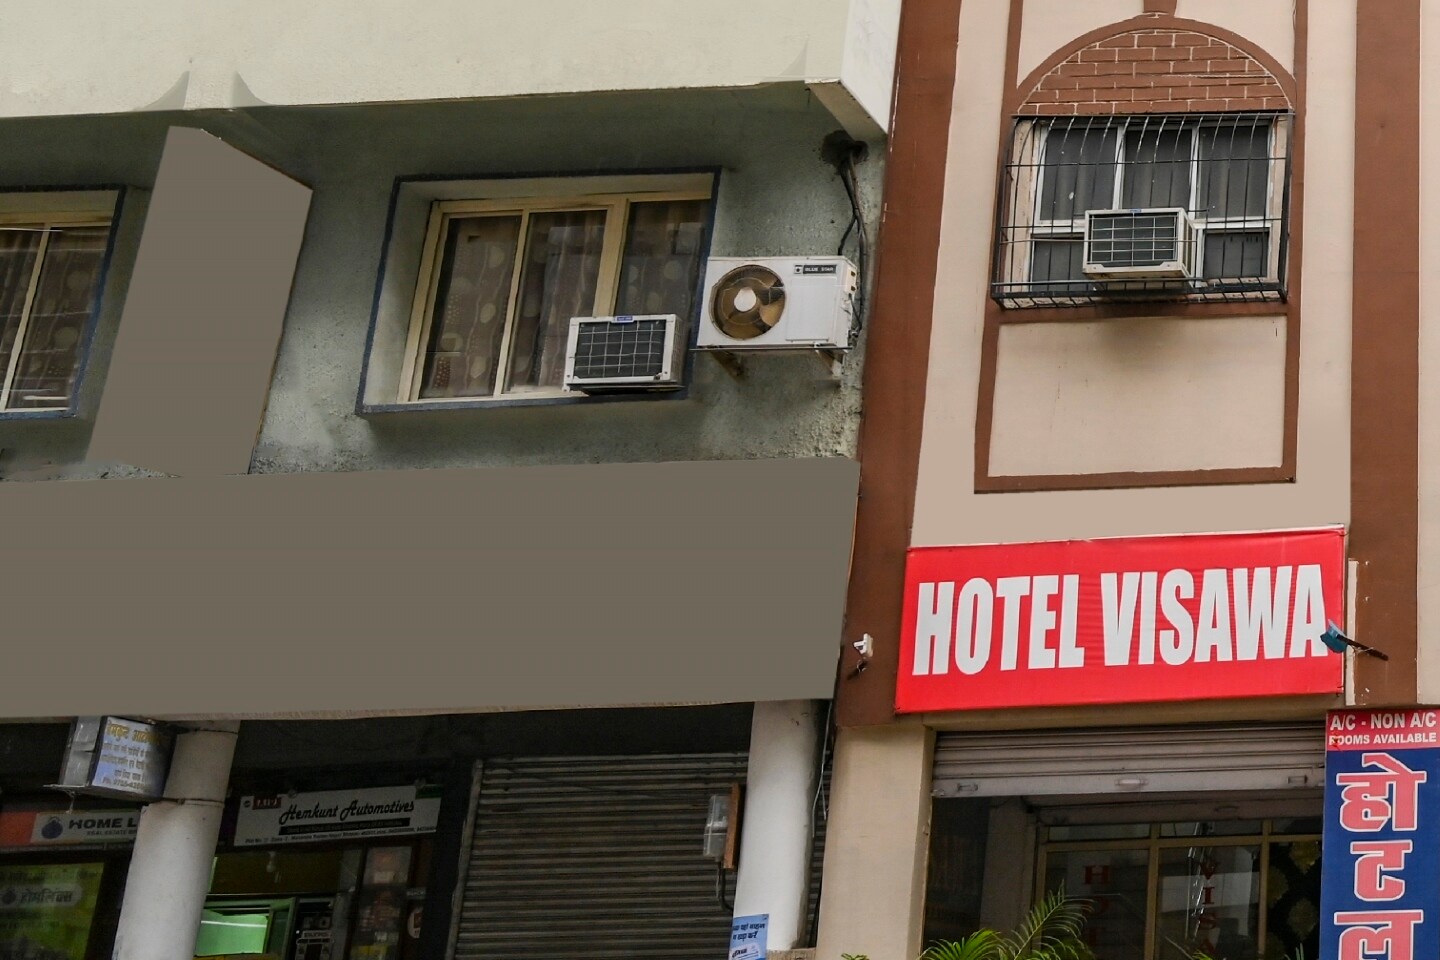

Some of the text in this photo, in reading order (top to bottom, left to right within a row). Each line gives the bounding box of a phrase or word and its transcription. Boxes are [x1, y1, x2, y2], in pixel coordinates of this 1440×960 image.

[912, 563, 1328, 676] HOTEL VISAWA
[1330, 714, 1356, 731] A/C
[1371, 713, 1406, 730] NON
[1410, 712, 1437, 728] A/C
[1328, 732, 1437, 746] ROOMS AVAILABLE
[279, 801, 339, 825] Hemkunt
[340, 799, 414, 821] Automotives
[69, 818, 123, 829] HOME
